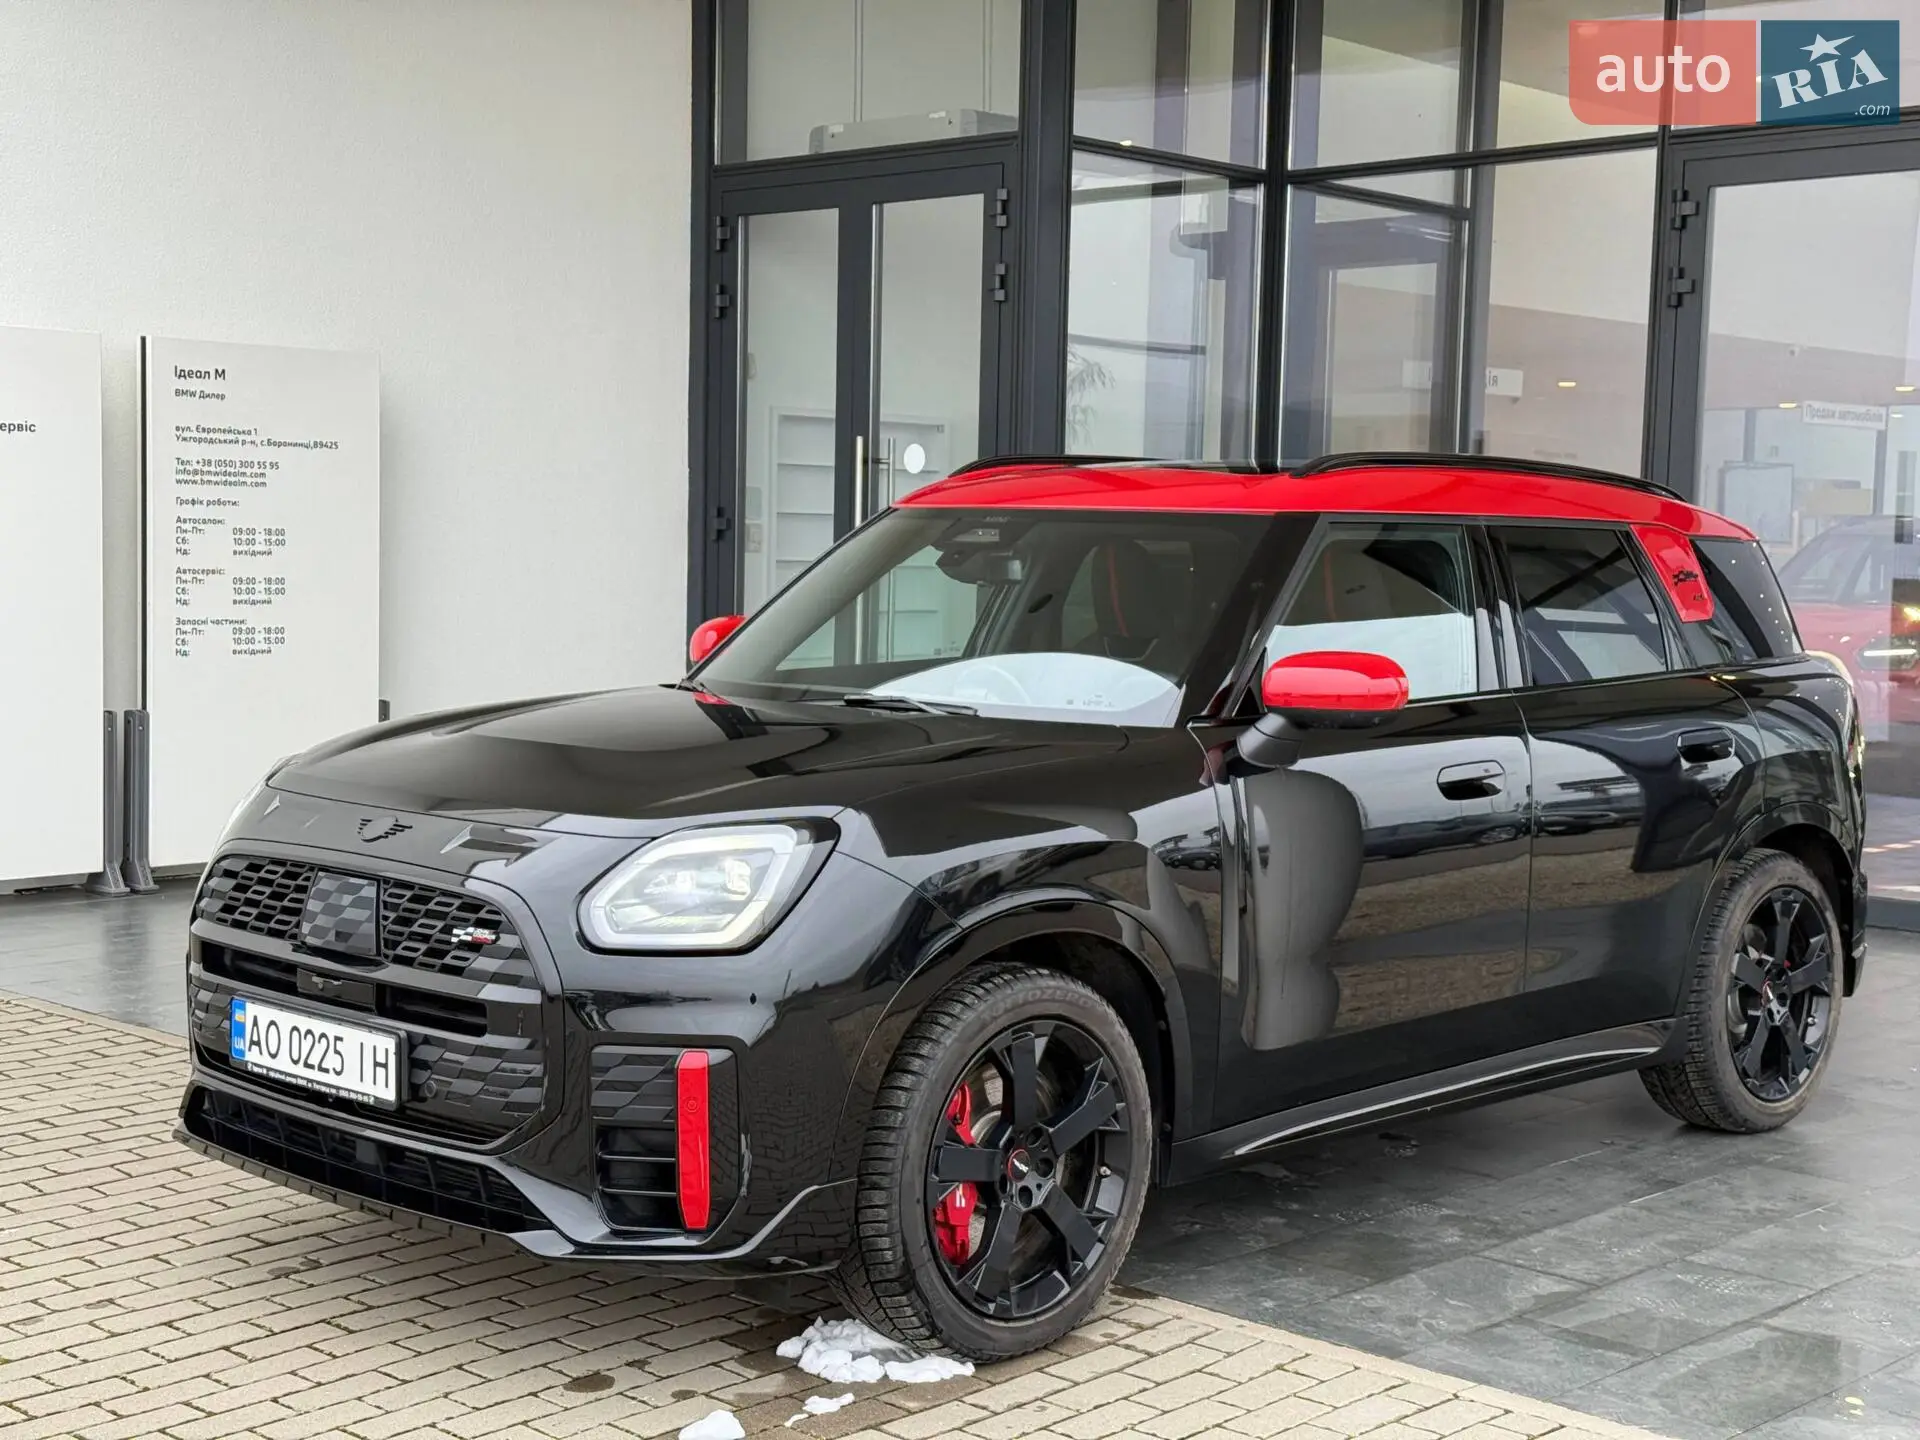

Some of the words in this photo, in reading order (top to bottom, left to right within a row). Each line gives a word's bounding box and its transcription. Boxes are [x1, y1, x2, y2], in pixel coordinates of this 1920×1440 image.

[174, 365, 211, 380] Ідеал
[215, 368, 226, 380] М
[175, 389, 197, 398] BMW
[198, 390, 226, 400] Дилер
[196, 424, 251, 436] Європейська
[175, 434, 239, 445] Ужгородський
[241, 438, 258, 447] р-н,
[176, 458, 193, 466] Тел:
[196, 459, 212, 467] +38
[214, 459, 236, 469] (050)
[238, 460, 255, 469] 300
[257, 461, 267, 469] 55
[269, 461, 279, 470] 95
[175, 468, 266, 479] info@bmwidealm.com
[175, 478, 267, 488] www.bmwidealm.com
[176, 497, 203, 507] Графік
[206, 498, 240, 508] роботи:
[176, 516, 225, 525] Автосалон:
[176, 526, 205, 535] Пн-Пт:
[233, 528, 256, 536] 09:00
[263, 528, 285, 536] 18:00
[176, 537, 190, 545] Сб:
[233, 538, 256, 546] 10:00
[263, 538, 286, 546] 15:00
[176, 547, 191, 556] Нд:
[233, 548, 272, 557] вихідний
[176, 567, 225, 576] Автосервіс:
[176, 577, 205, 585] Пн-Пт:
[233, 577, 256, 585] 09:00
[263, 577, 285, 585] 18:00
[176, 587, 190, 595] Сб:
[233, 587, 256, 595] 10:00
[264, 587, 286, 595] 15:00
[176, 598, 190, 606] Нд:
[233, 597, 272, 606] вихідний
[176, 617, 209, 626] Запасні
[176, 628, 205, 636] Пн-Пт:
[232, 627, 256, 635] 09:00
[263, 627, 285, 635] 18:00
[176, 638, 189, 646] Сб:
[232, 637, 256, 645] 10:00
[263, 637, 285, 645] 15:00
[176, 648, 190, 656] Нд:
[232, 647, 272, 656] вихідний
[248, 1014, 281, 1059] AO
[289, 1025, 344, 1076] 0225
[360, 1042, 388, 1088] IH
